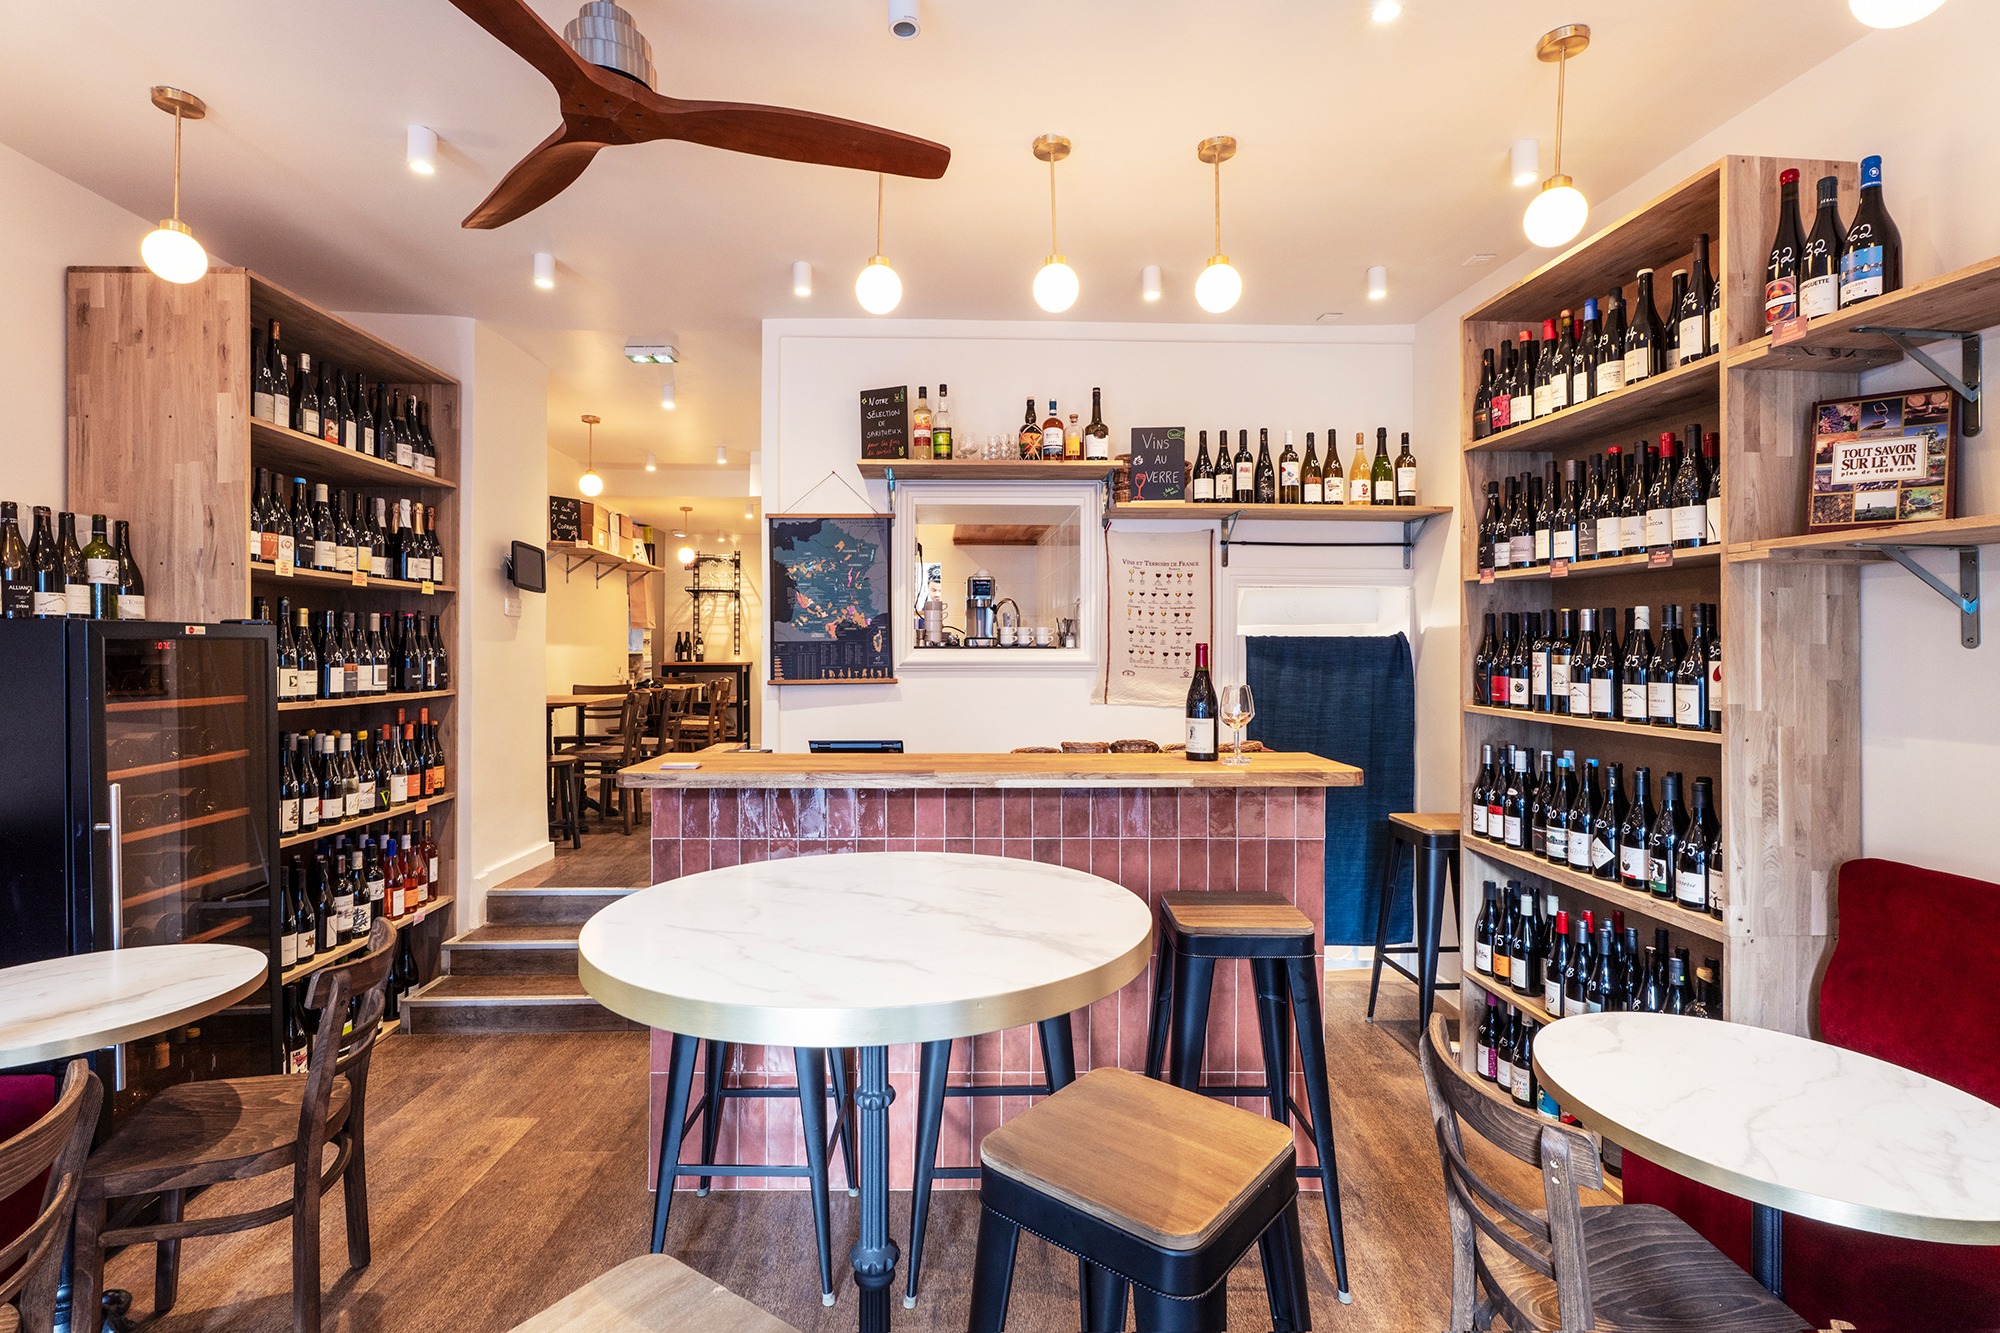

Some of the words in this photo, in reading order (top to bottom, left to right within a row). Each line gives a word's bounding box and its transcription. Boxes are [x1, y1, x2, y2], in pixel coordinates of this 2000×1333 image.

[1847, 224, 1873, 241] 62
[1804, 239, 1827, 260] 32
[1768, 247, 1794, 269] 32
[1842, 447, 1873, 458] TOUT
[1875, 443, 1917, 456] SAVOIR
[1154, 455, 1167, 464] AU
[1841, 457, 1868, 470] SUR
[1871, 456, 1888, 468] LE
[1891, 454, 1916, 466] VIN
[1145, 471, 1179, 483] VERRE
[1580, 522, 1589, 535] R
[1592, 654, 1607, 669] 25
[1624, 654, 1640, 669] 25
[1678, 840, 1698, 857] 25
[1494, 933, 1504, 946] 15
[1512, 936, 1522, 949] 16
